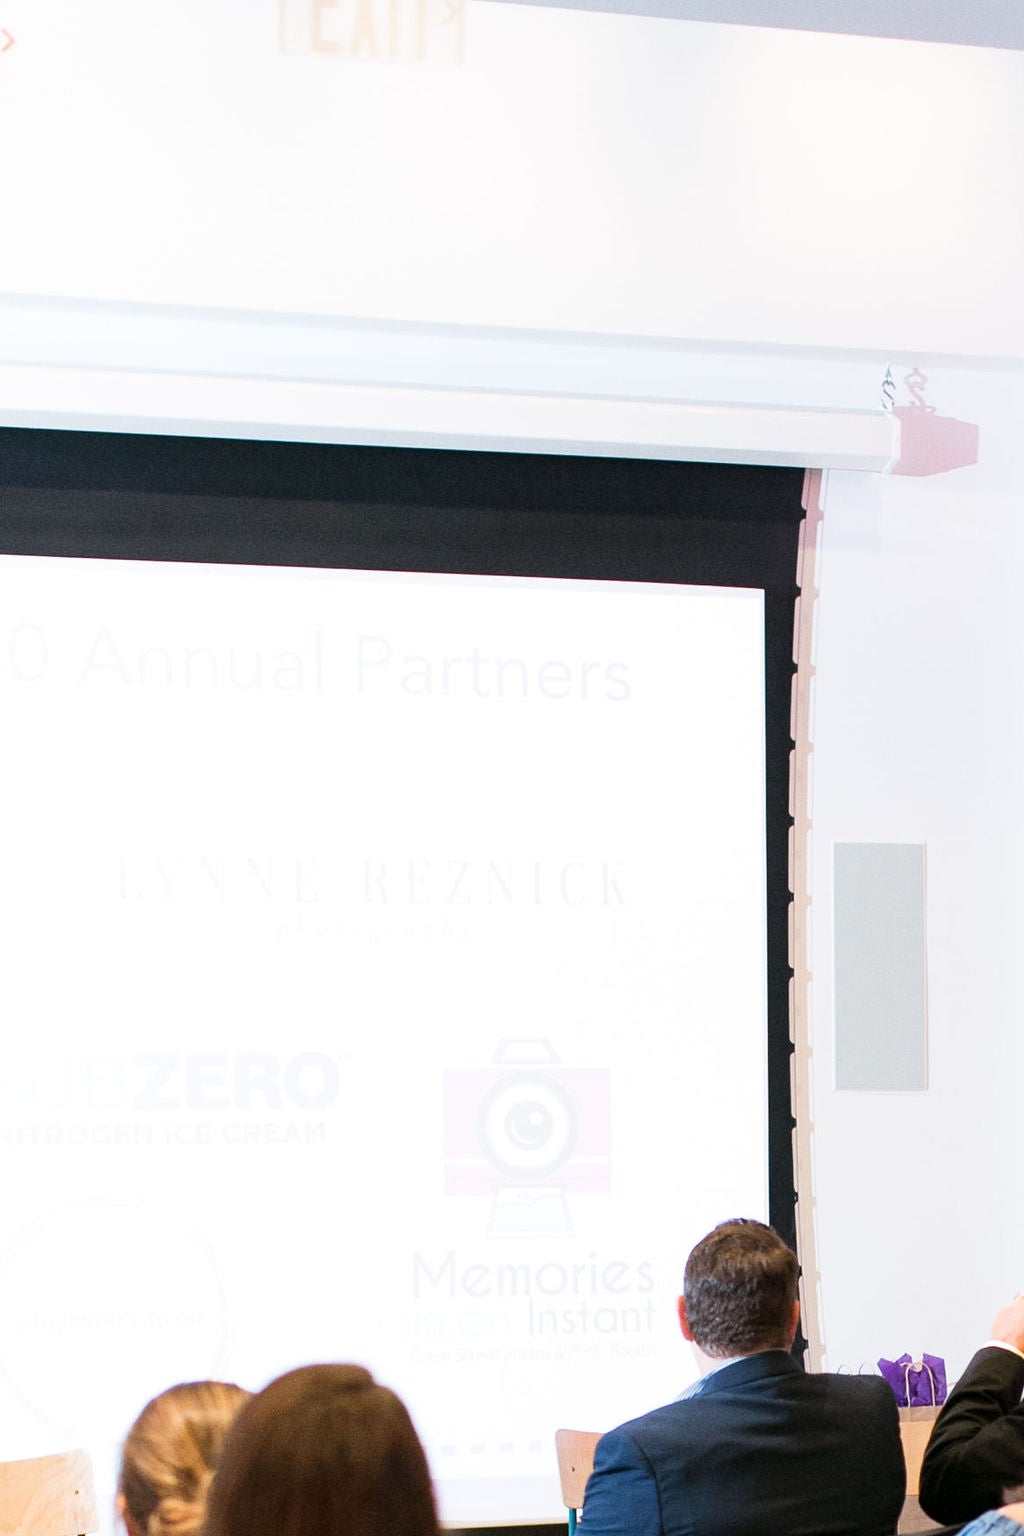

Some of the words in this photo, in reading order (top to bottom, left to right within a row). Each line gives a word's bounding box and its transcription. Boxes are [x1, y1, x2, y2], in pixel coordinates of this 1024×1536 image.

[76, 623, 323, 694] Annual
[357, 634, 632, 702] Partners
[363, 857, 628, 909] REZNICK
[166, 1123, 212, 1145] ICE
[222, 1121, 327, 1145] CREAM
[413, 1250, 655, 1298] Memories
[529, 1297, 656, 1335] Instant
